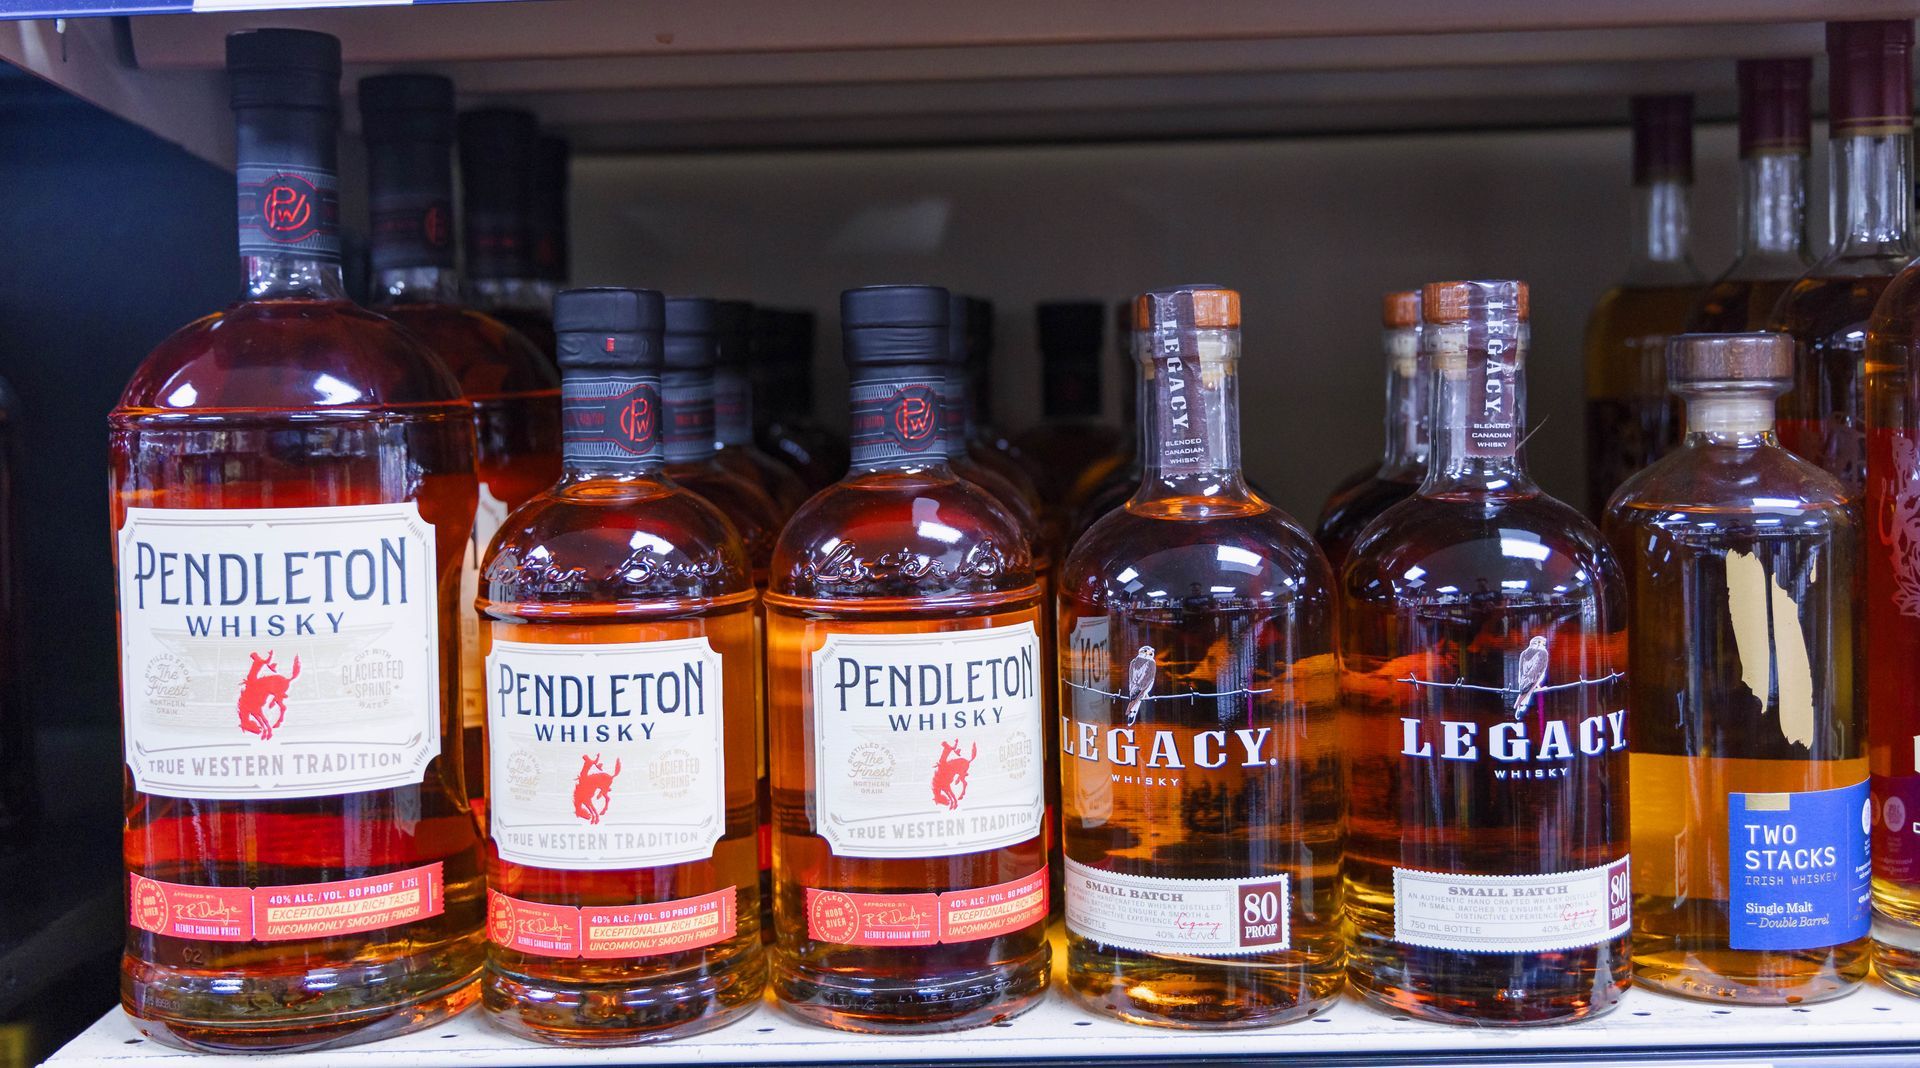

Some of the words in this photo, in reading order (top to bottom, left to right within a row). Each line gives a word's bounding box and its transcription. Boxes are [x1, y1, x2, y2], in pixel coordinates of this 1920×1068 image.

[1165, 438, 1202, 447] BLENDED
[1165, 447, 1204, 456] CANADIAN
[134, 536, 408, 609] PENDLETON
[186, 612, 344, 637] WHISKY
[158, 664, 179, 682] The
[342, 662, 384, 685] GLACIER
[386, 660, 404, 680] FED
[834, 644, 1033, 711] PENDLETON
[145, 675, 189, 696] Finest
[355, 680, 391, 698] SPRING
[498, 660, 704, 718] PENDLETON
[889, 706, 1003, 731] WHISKY
[535, 722, 655, 742] WHISKY
[148, 760, 185, 774] TRUE
[192, 754, 284, 776] WESTERN
[293, 752, 401, 775] TRADITION
[862, 751, 884, 766] The
[848, 761, 893, 777] Finest
[1494, 767, 1568, 779] WHISKY
[1111, 773, 1179, 787] WHISKY
[848, 827, 886, 840] TRUE
[892, 818, 965, 839] WESTERN
[971, 812, 1032, 836] TRADITION
[1744, 824, 1797, 845] TWO
[507, 834, 534, 847] TRUE
[538, 833, 607, 850] WESTERN
[614, 832, 698, 849] TRADITION
[1745, 846, 1836, 870] STACKS
[1611, 872, 1627, 905] 80
[1745, 875, 1784, 886] IRISH
[1791, 872, 1838, 885] WHISKEY
[269, 895, 291, 904] 40%
[349, 889, 361, 898] 80
[363, 883, 394, 895] PROOF
[950, 900, 967, 908] 40%
[1017, 884, 1033, 896] PROOF
[1086, 880, 1126, 897] SMALL
[1129, 889, 1184, 902] BATCH
[1420, 894, 1465, 904] AUTHENTIC
[1534, 896, 1563, 904] WHISKY
[1448, 886, 1508, 897] SMALL
[1513, 885, 1568, 897] BATCH
[272, 904, 358, 920] EXCEPTIONALLY
[361, 897, 386, 911] RICH
[388, 891, 417, 905] TASTE
[592, 915, 610, 924] 40%
[672, 905, 698, 917] PROOF
[952, 901, 1016, 921] EXCEPTIONALLY
[1129, 906, 1157, 916] ENSURE
[1148, 902, 1176, 910] WHISKY
[1244, 891, 1278, 923] 80
[1430, 903, 1455, 911] SMALL
[1512, 905, 1543, 913] ENSURE
[1745, 903, 1783, 915] Single
[1786, 902, 1813, 913] Malt
[268, 920, 346, 935] UNCOMMONLY
[347, 911, 389, 928] SMOOTH
[390, 906, 420, 921] FINISH
[593, 923, 670, 937] EXCEPTIONALLY
[671, 919, 692, 931] RICH
[693, 914, 716, 927] TASTE
[949, 917, 1005, 935] UNCOMMONLY
[1174, 912, 1222, 936] Legacy
[1410, 920, 1425, 929] 750
[1444, 925, 1481, 934] BOTTLE
[1759, 917, 1797, 929] Double
[1798, 914, 1829, 928] Barrel
[221, 927, 240, 936] WHISKY
[590, 937, 656, 950] UNCOMMONLY
[658, 931, 694, 945] SMOOTH
[695, 927, 718, 940] FINISH
[912, 930, 930, 938] WHISKY
[1156, 931, 1174, 939] 40%
[1245, 923, 1278, 939] PROOF
